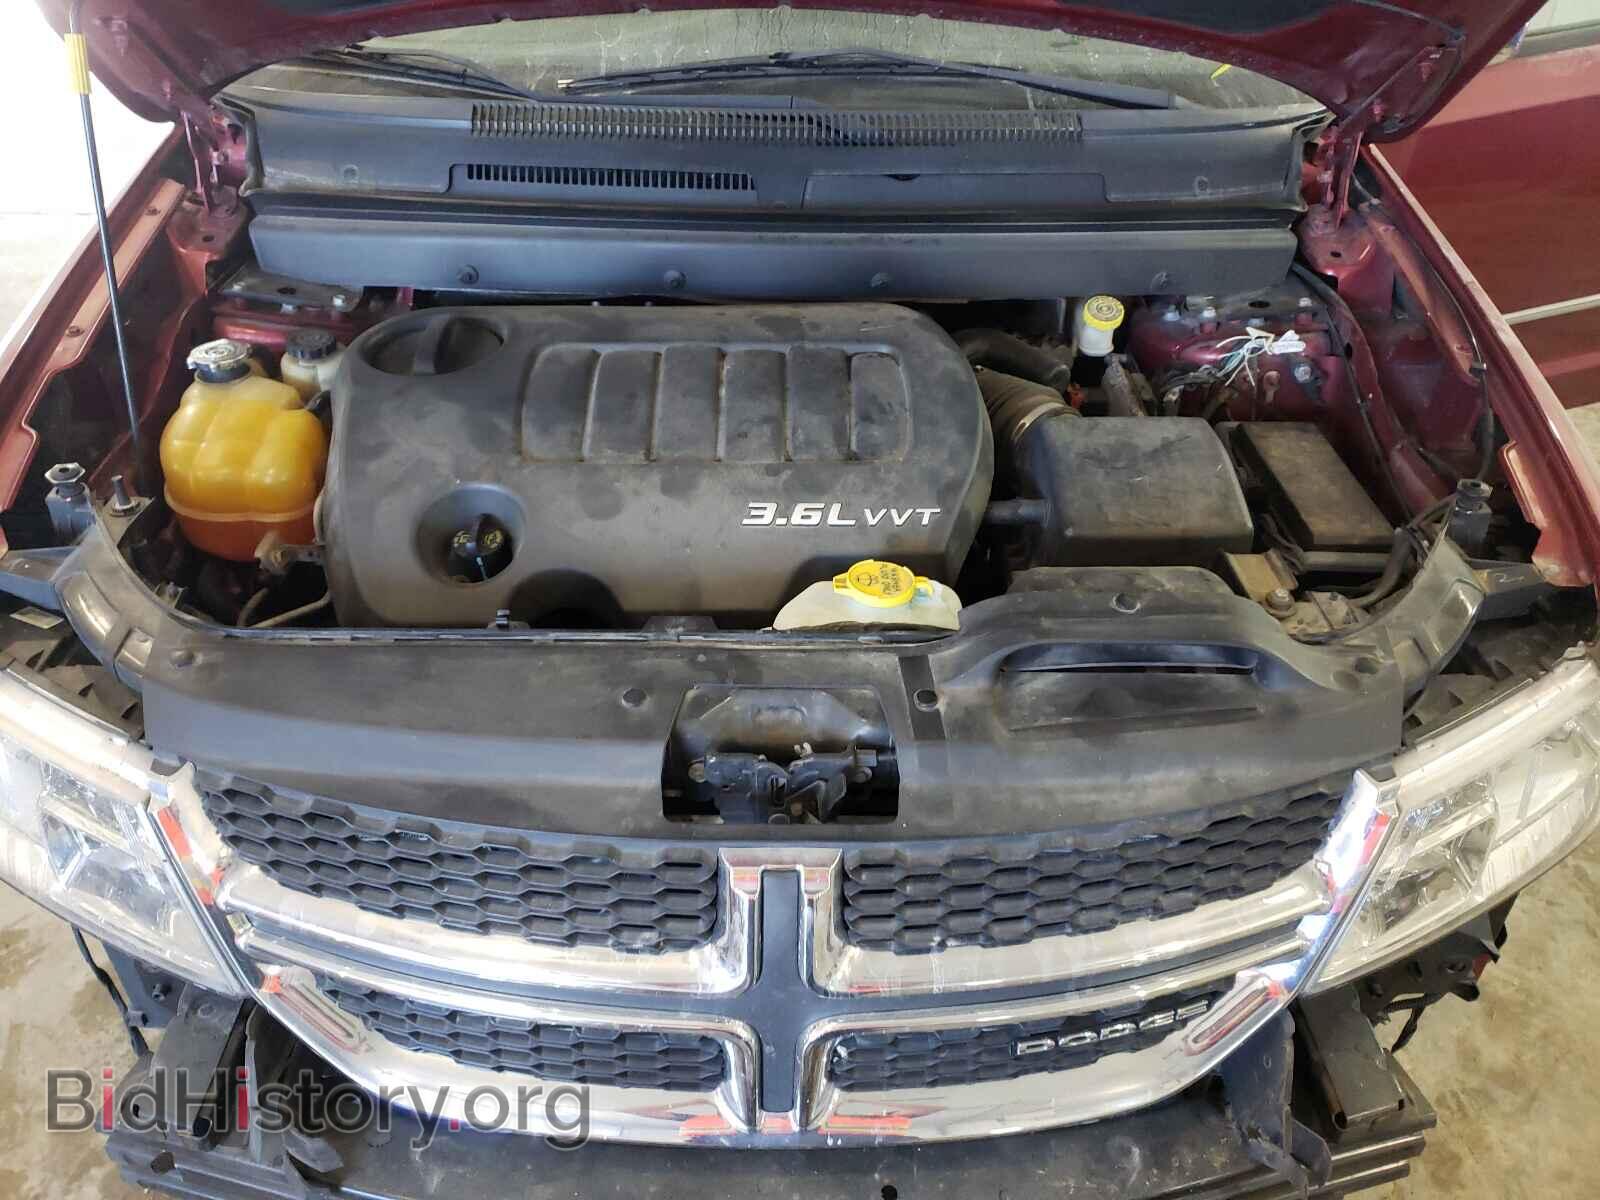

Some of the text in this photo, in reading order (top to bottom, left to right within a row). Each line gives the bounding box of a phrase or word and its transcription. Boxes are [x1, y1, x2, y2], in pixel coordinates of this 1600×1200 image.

[741, 501, 941, 526] 3.6L VVT
[1017, 999, 1209, 1056] DODGE
